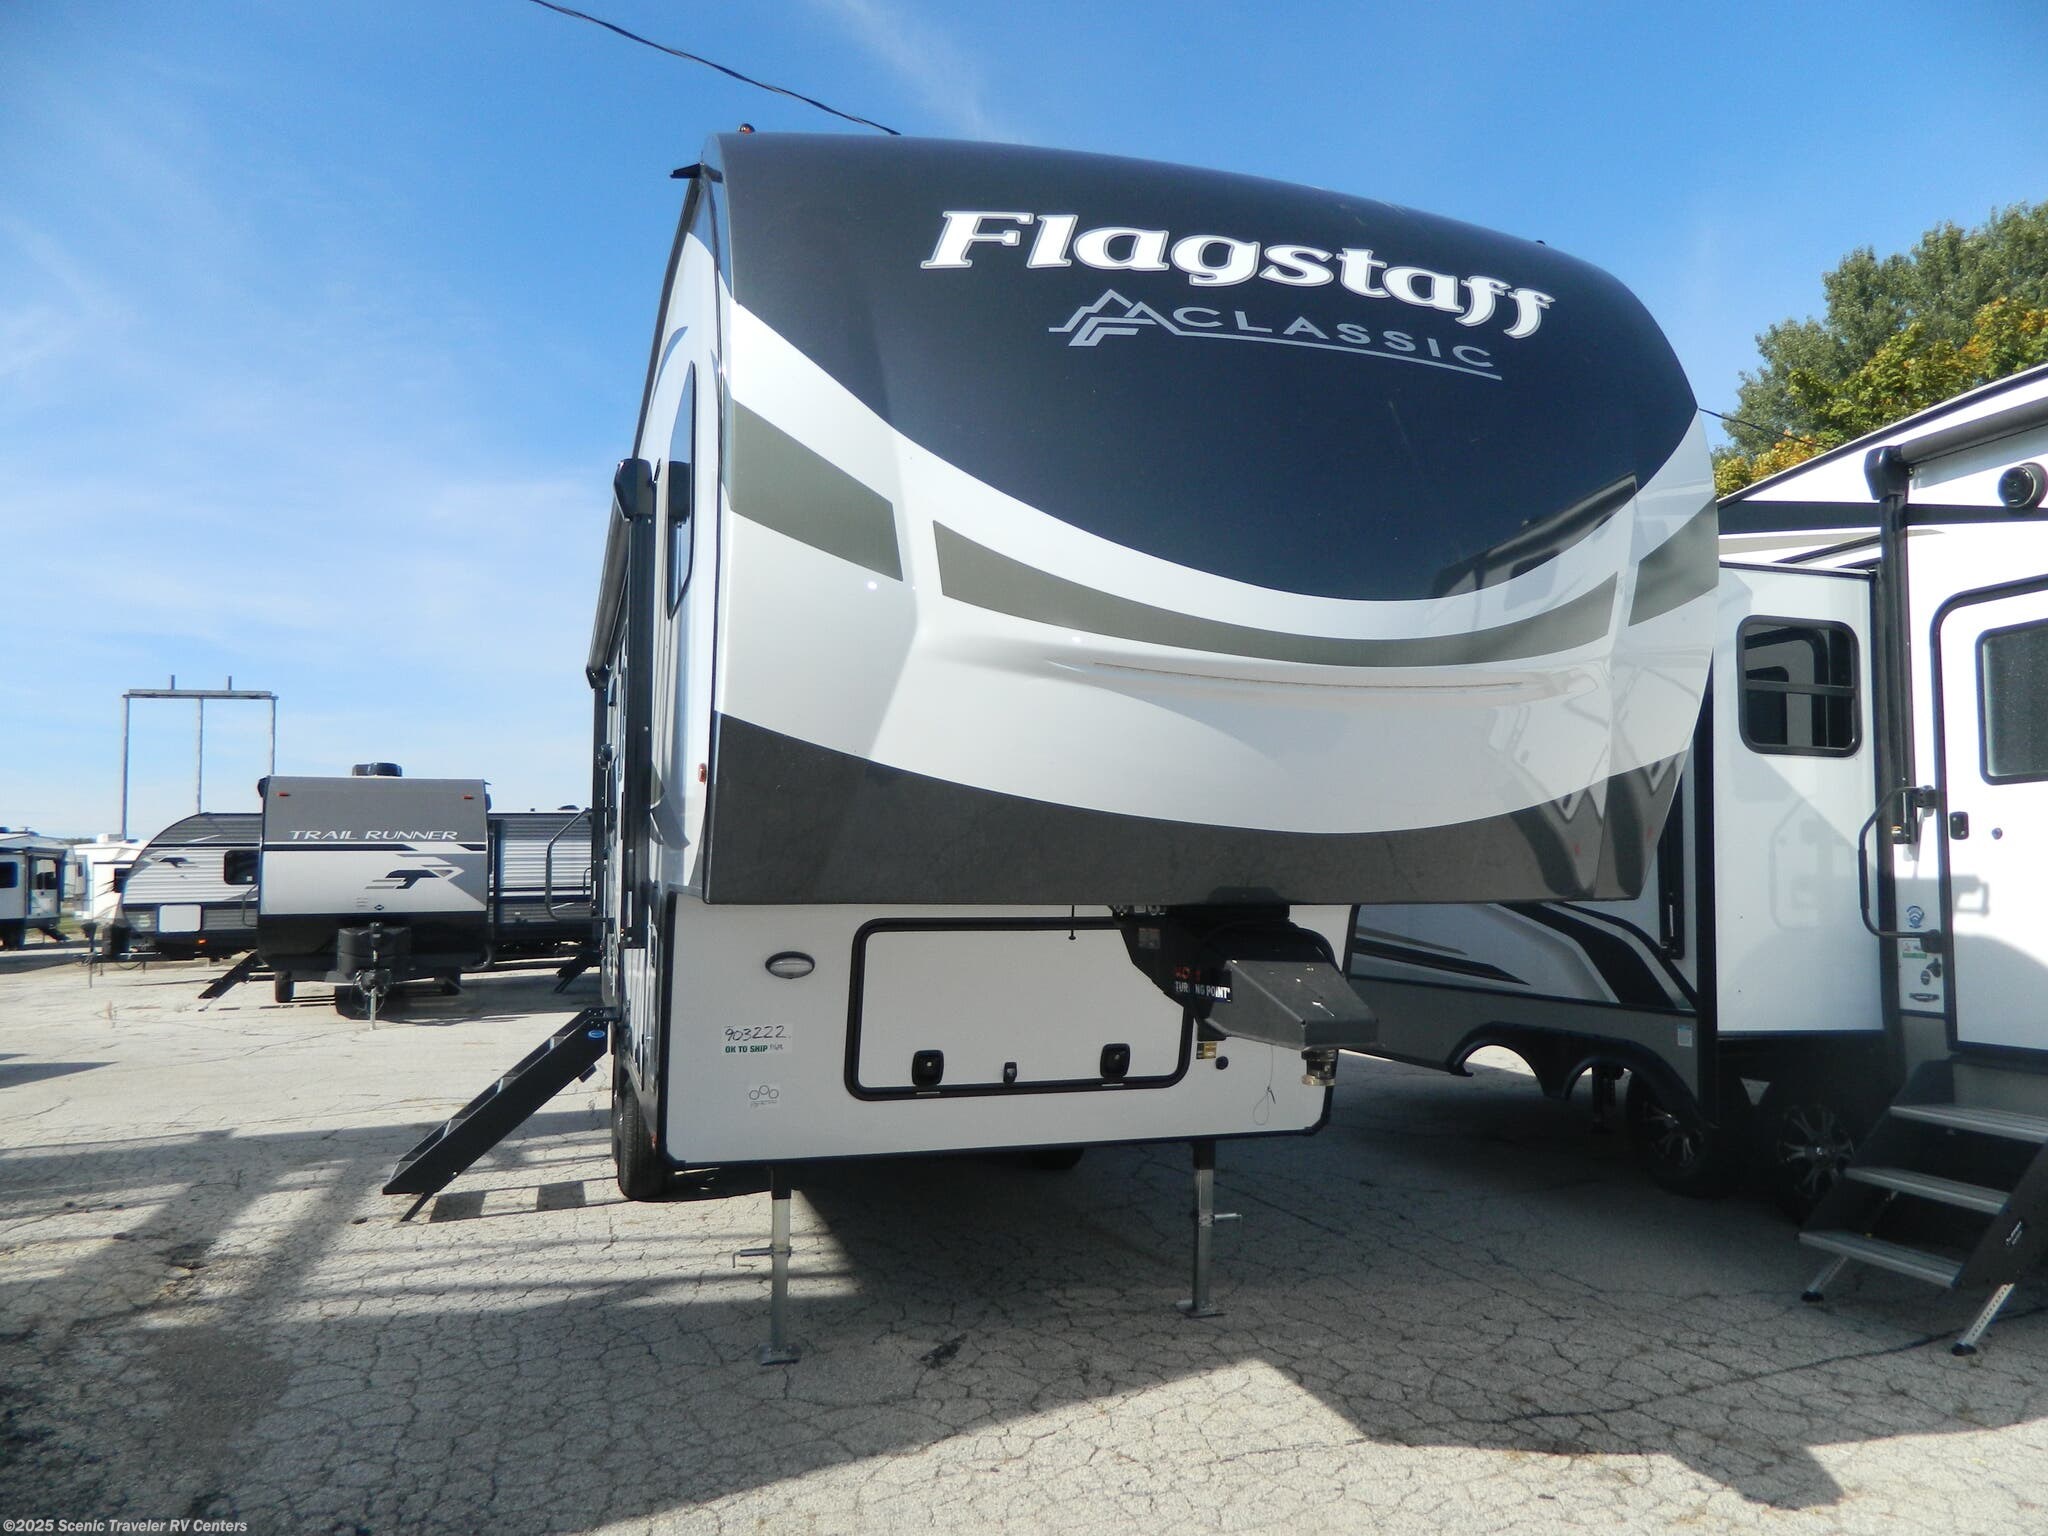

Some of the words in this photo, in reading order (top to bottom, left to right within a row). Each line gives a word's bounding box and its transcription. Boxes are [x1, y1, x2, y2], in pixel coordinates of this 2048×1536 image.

[920, 210, 1556, 339] Flagstaff
[1171, 306, 1494, 369] CLASSIC
[288, 830, 358, 841] TRAIL
[365, 830, 459, 841] RUNNER
[724, 1045, 736, 1053] OK
[738, 1045, 748, 1053] TO
[750, 1044, 768, 1053] SHIP
